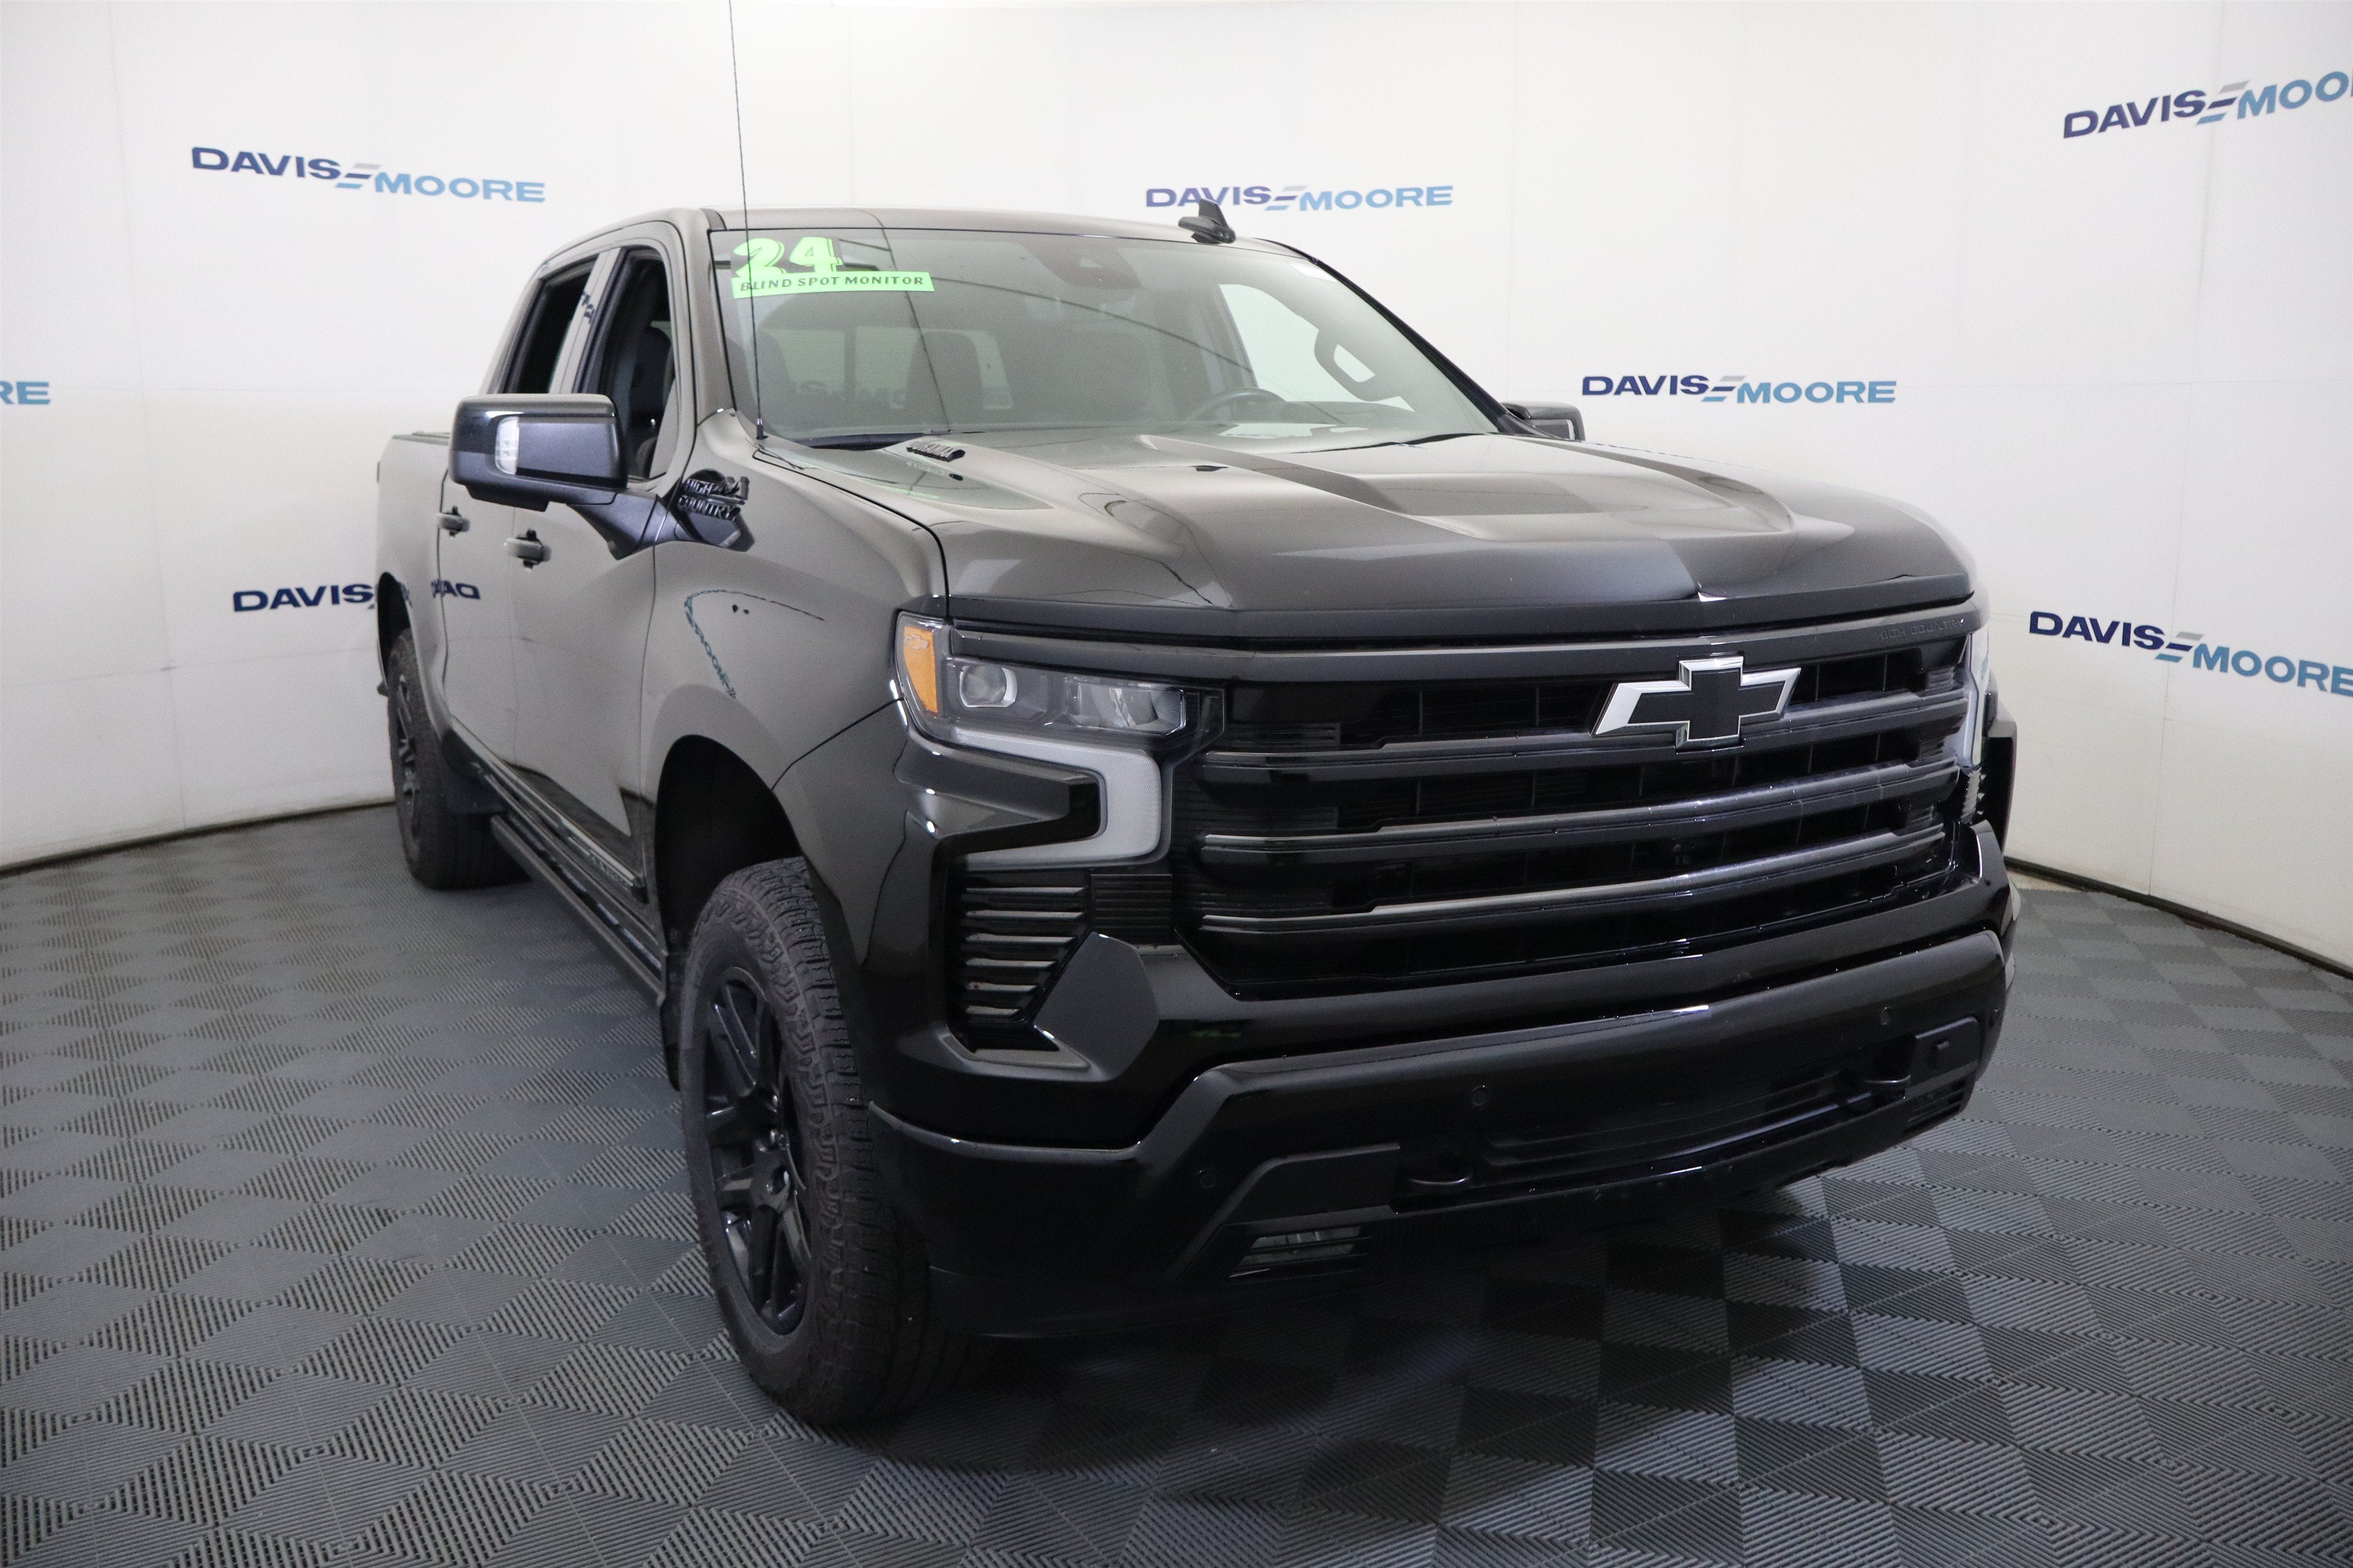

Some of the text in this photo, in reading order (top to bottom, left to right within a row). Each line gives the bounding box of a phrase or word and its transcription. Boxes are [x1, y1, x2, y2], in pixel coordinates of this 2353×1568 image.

[2063, 70, 2353, 138] DAVIS MOO
[192, 146, 545, 203] DAVIS MOORE
[1146, 185, 1453, 211] DAVIS MOORE
[733, 237, 843, 277] 24
[740, 276, 923, 291] BLIND SPOT MONITOR
[1581, 374, 1897, 403] DAVIS MOORE
[233, 583, 375, 612] DAVIS
[2029, 610, 2353, 698] DAVIS MOORE
